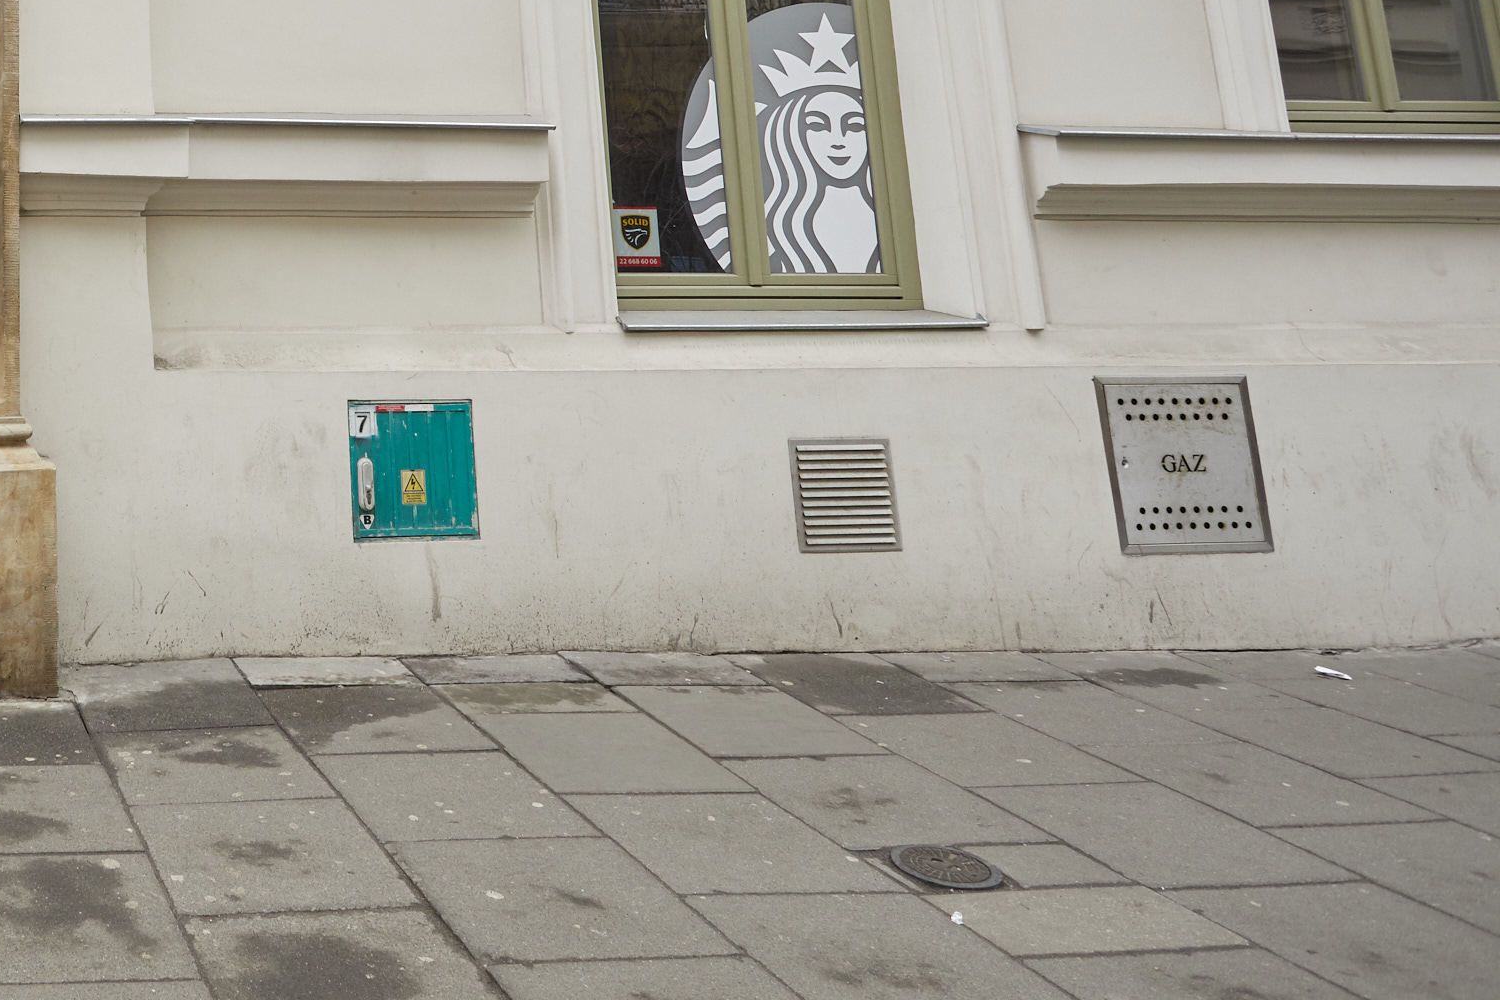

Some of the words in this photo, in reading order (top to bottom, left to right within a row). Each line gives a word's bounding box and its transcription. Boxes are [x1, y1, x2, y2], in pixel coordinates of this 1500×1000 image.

[622, 218, 648, 226] SOLID
[357, 415, 367, 433] 7
[1161, 454, 1207, 472] GAZ
[363, 515, 372, 525] B
